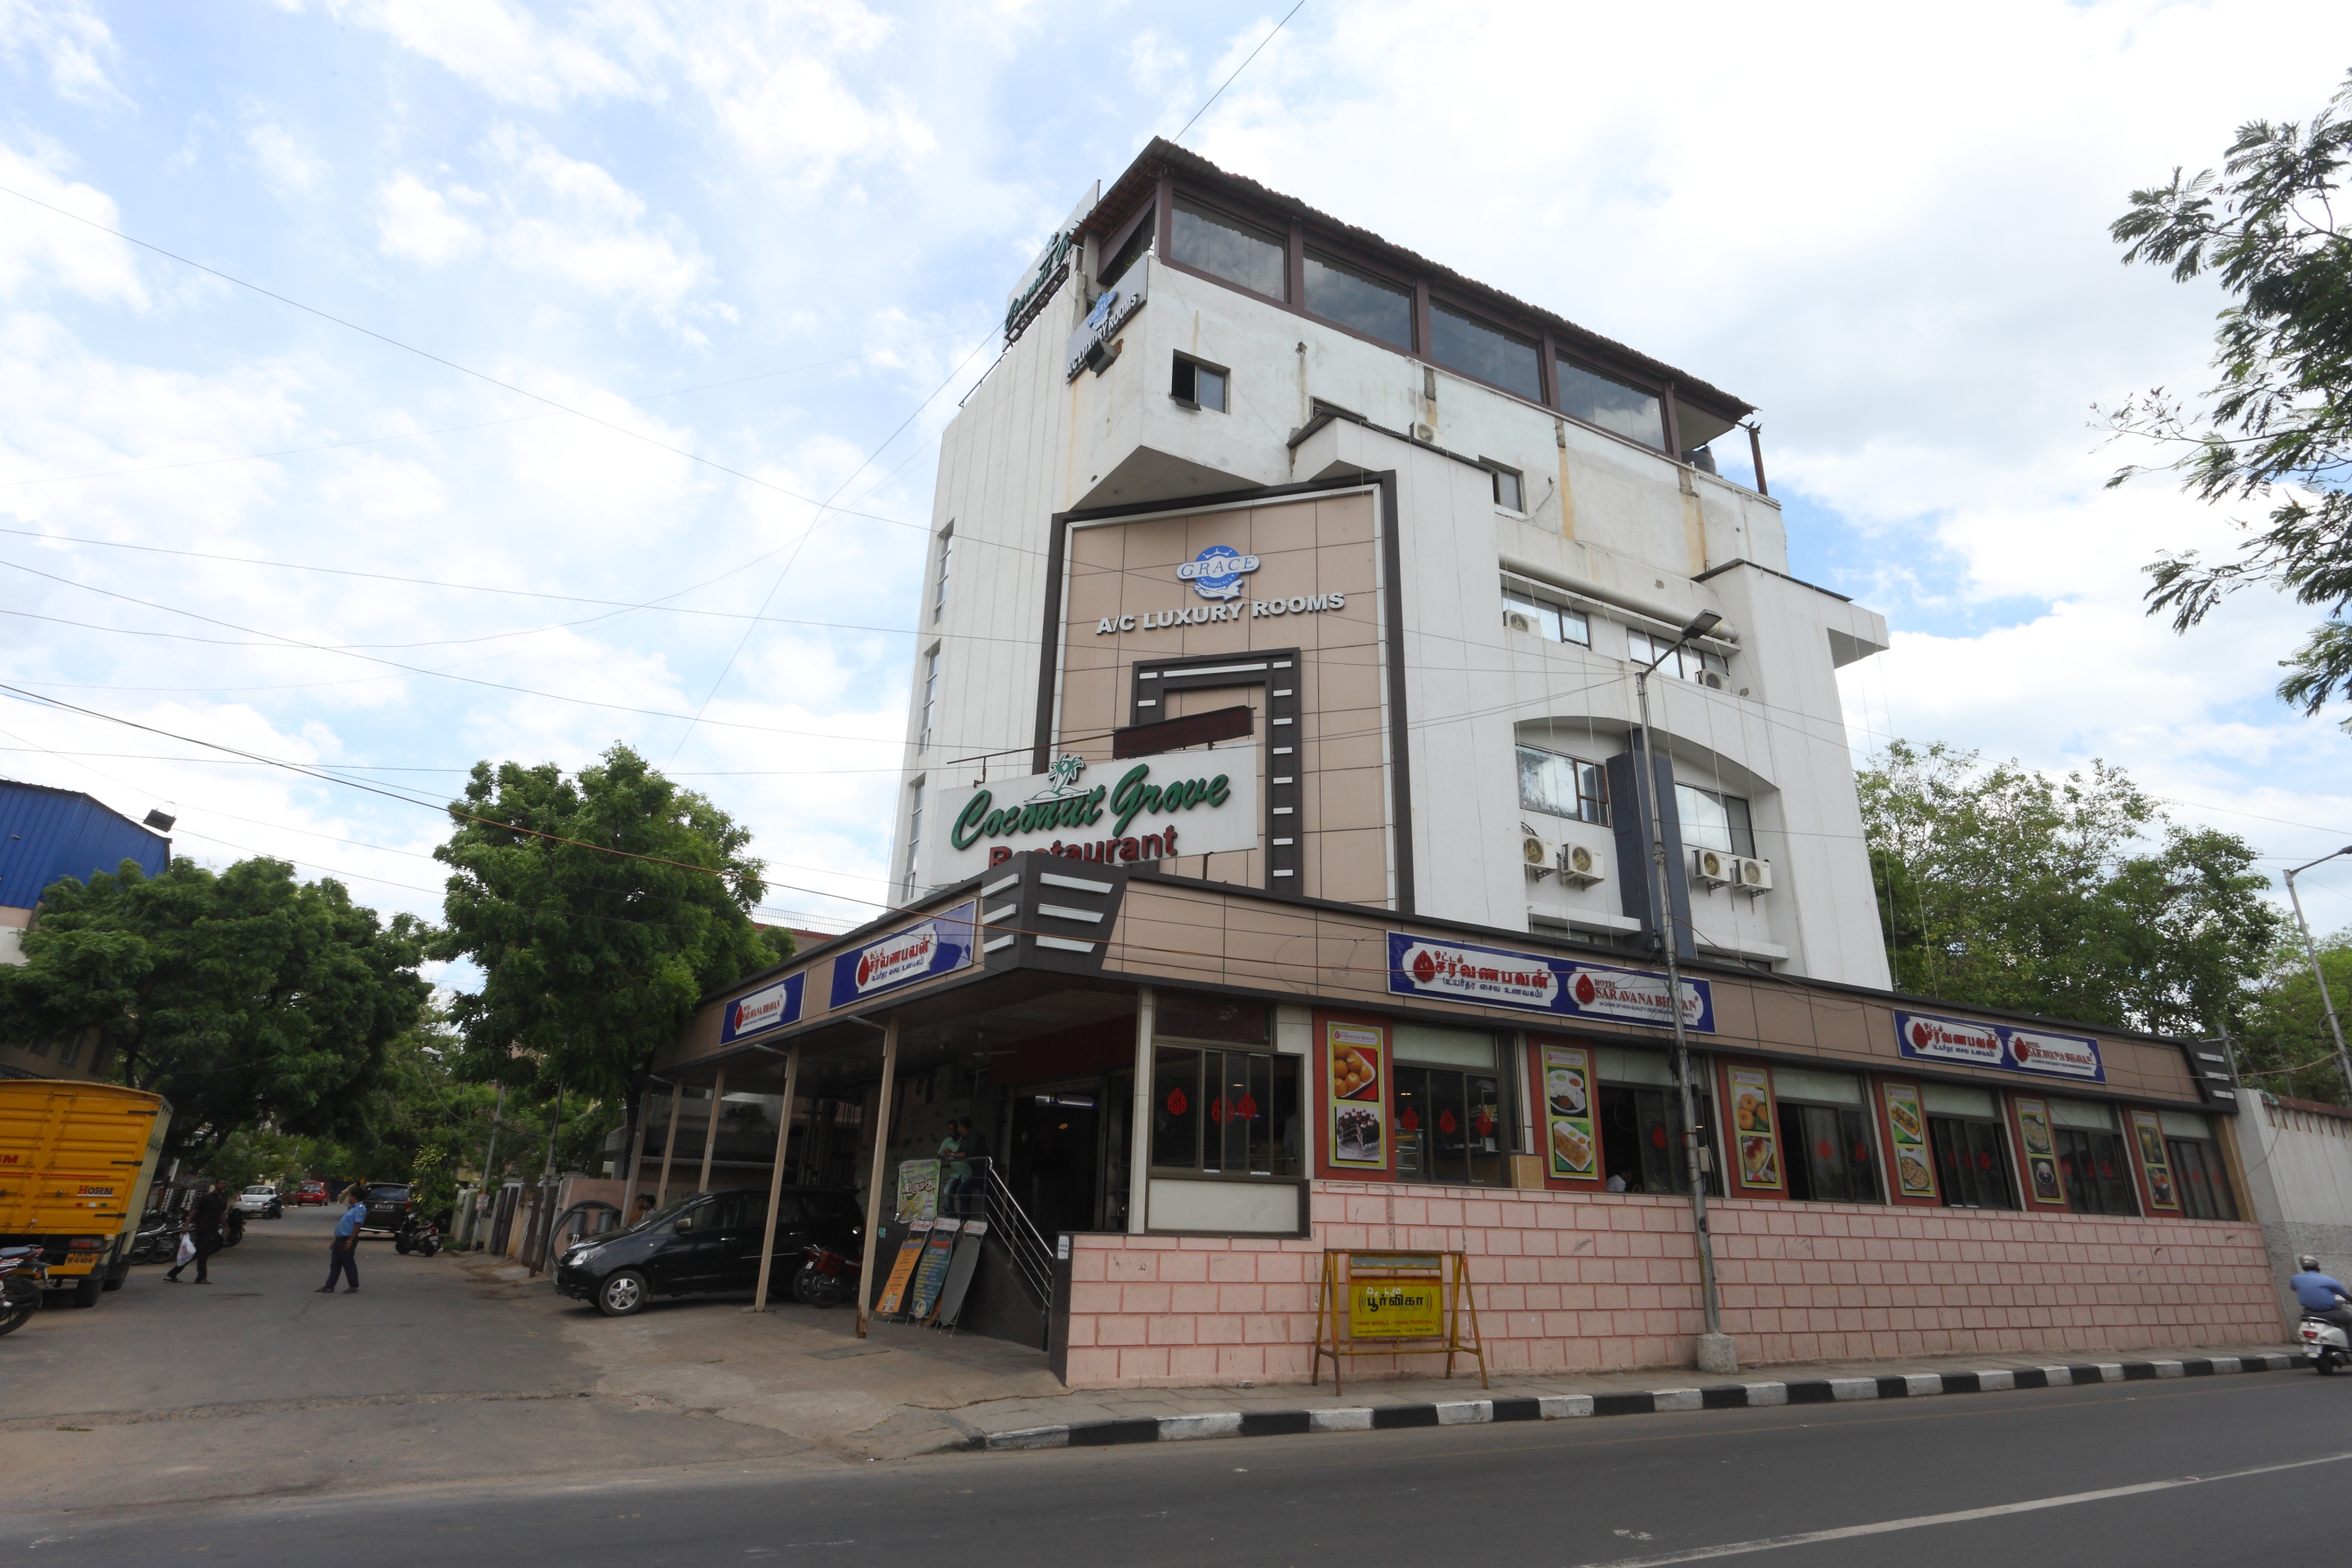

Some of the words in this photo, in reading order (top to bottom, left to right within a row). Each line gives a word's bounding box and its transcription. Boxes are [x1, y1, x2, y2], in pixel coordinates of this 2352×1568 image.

[1108, 292, 1137, 332] ROOMS
[1181, 556, 1255, 577] GRACE
[1203, 577, 1232, 586] RESIDENCY
[1096, 614, 1135, 635] A/C
[1143, 602, 1245, 629] LUXURY
[1252, 592, 1346, 618] ROOMS
[951, 784, 1107, 850] Coconut
[1110, 764, 1232, 837] Grove
[989, 825, 1178, 870] Rtaurant
[1436, 961, 1548, 988] சரவணபவன்
[1594, 979, 1616, 988] HOTEL
[1655, 995, 1696, 1010] BHAN
[78, 1186, 114, 1196] HORN
[1367, 1294, 1423, 1312] பூர்விகா
